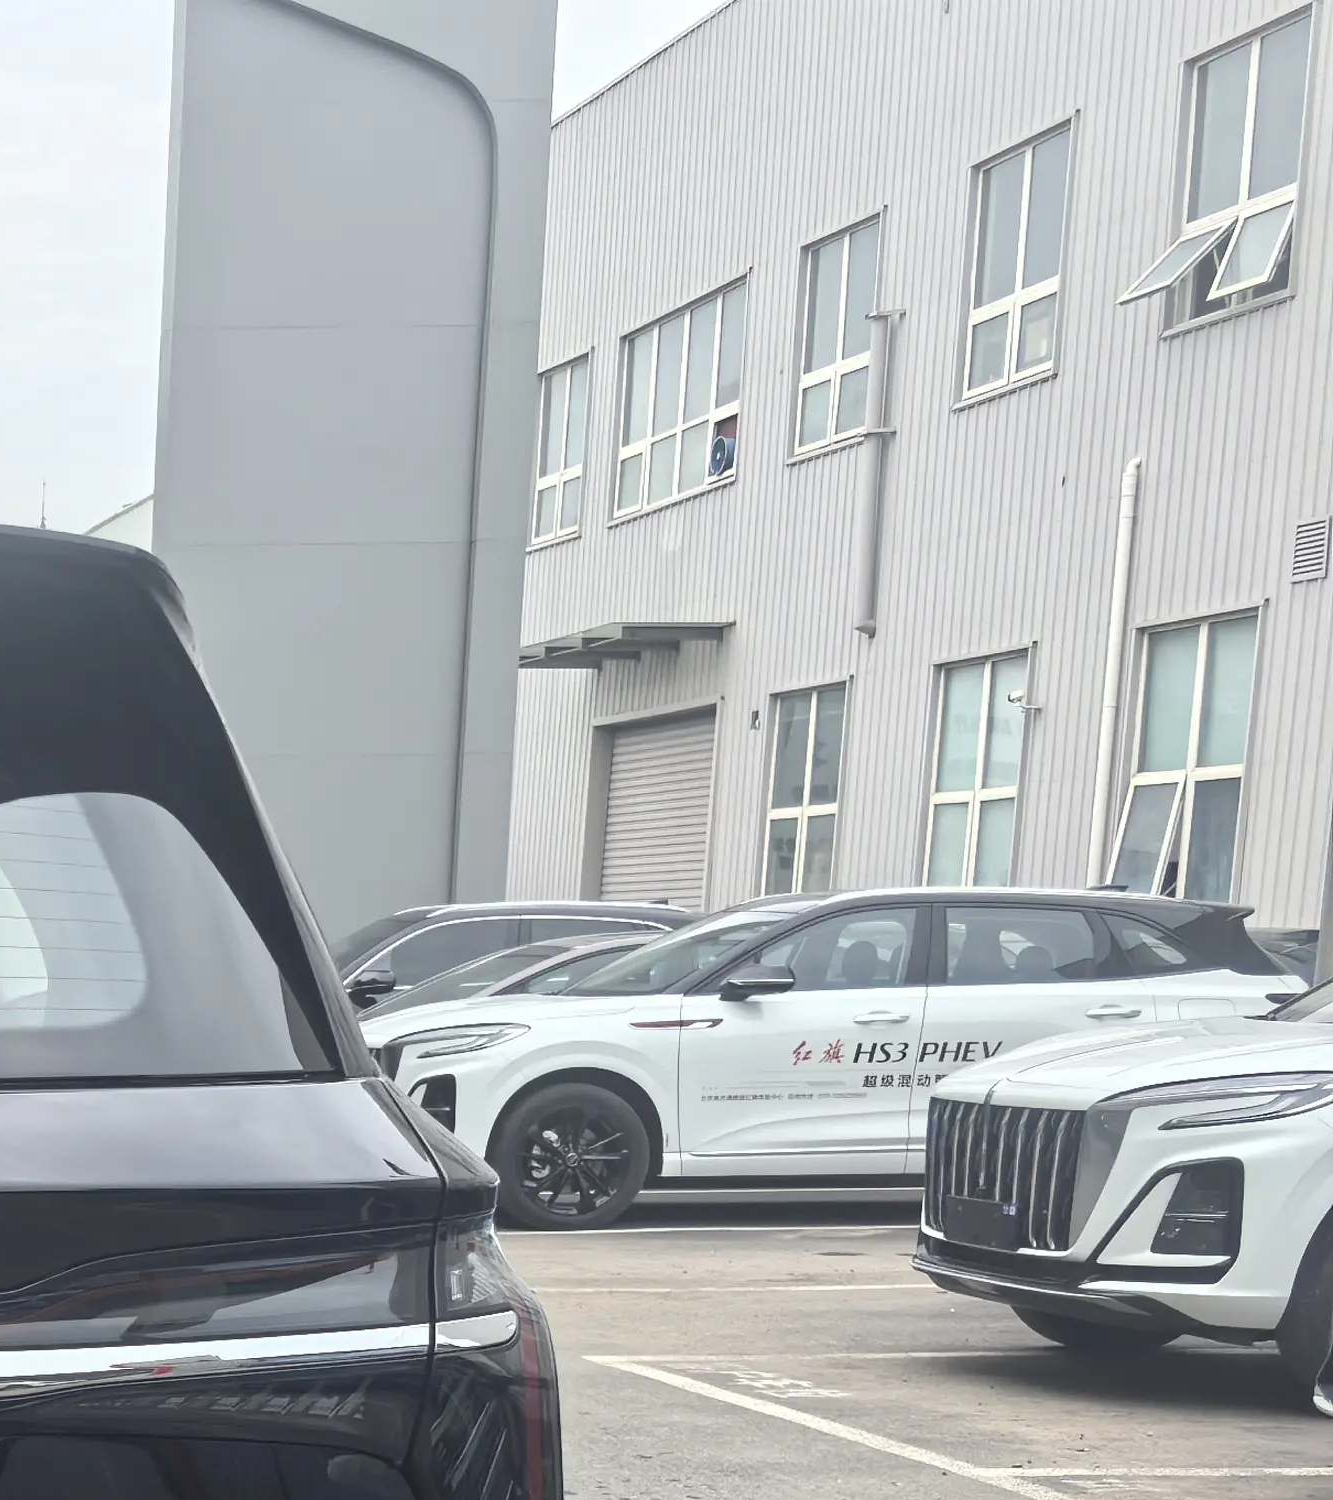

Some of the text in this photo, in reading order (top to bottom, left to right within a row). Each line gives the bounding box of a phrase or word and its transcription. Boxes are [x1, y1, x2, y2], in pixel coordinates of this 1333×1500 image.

[792, 1039, 1003, 1066] 红旗 HS3 PHEV
